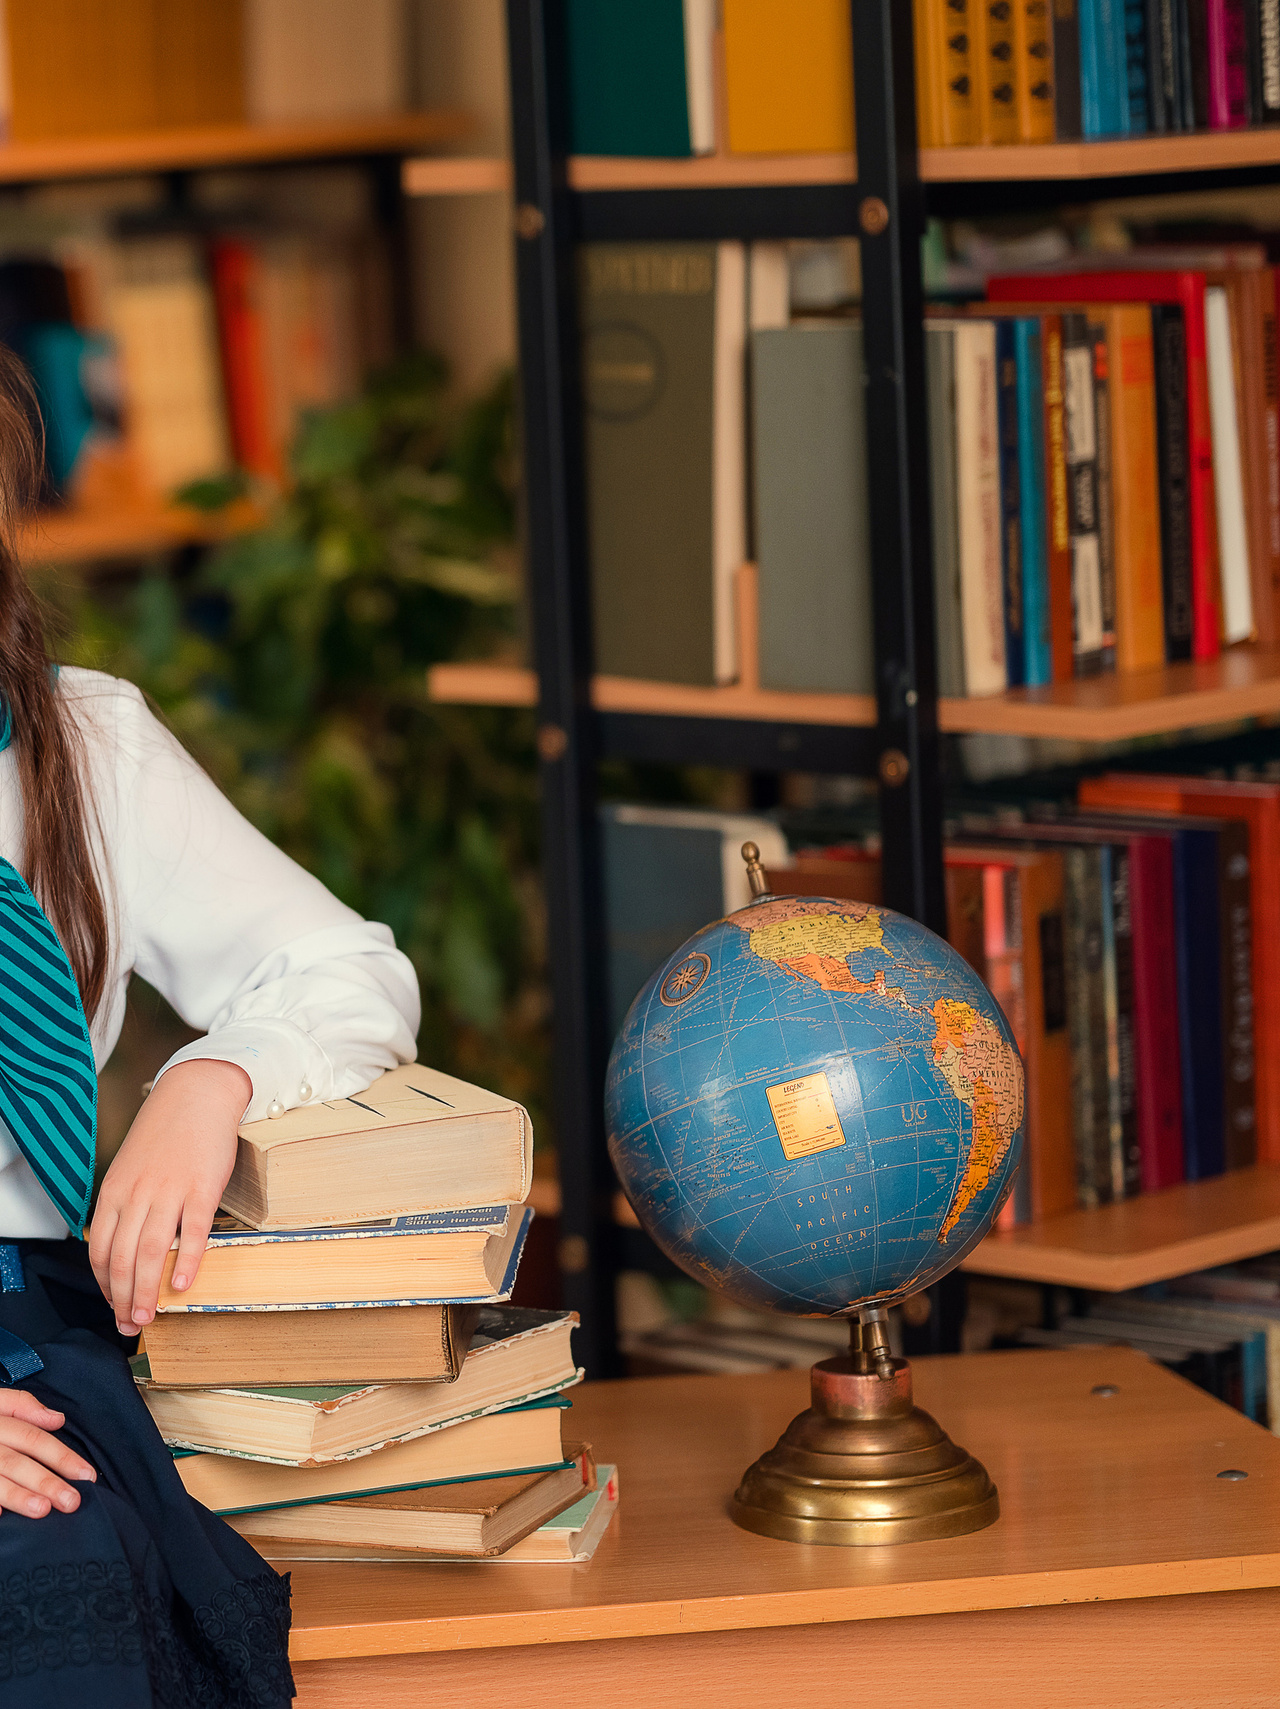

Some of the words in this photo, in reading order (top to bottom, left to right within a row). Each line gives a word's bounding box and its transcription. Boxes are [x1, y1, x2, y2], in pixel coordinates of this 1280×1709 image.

[783, 1082, 805, 1093] LEGEND
[901, 1103, 928, 1122] UG
[797, 1185, 852, 1207] SOUTH
[405, 1218, 446, 1226] Sidney
[450, 1215, 498, 1224] Herbert
[795, 1205, 870, 1231] PACIFIC
[810, 1229, 867, 1250] OCEAN
